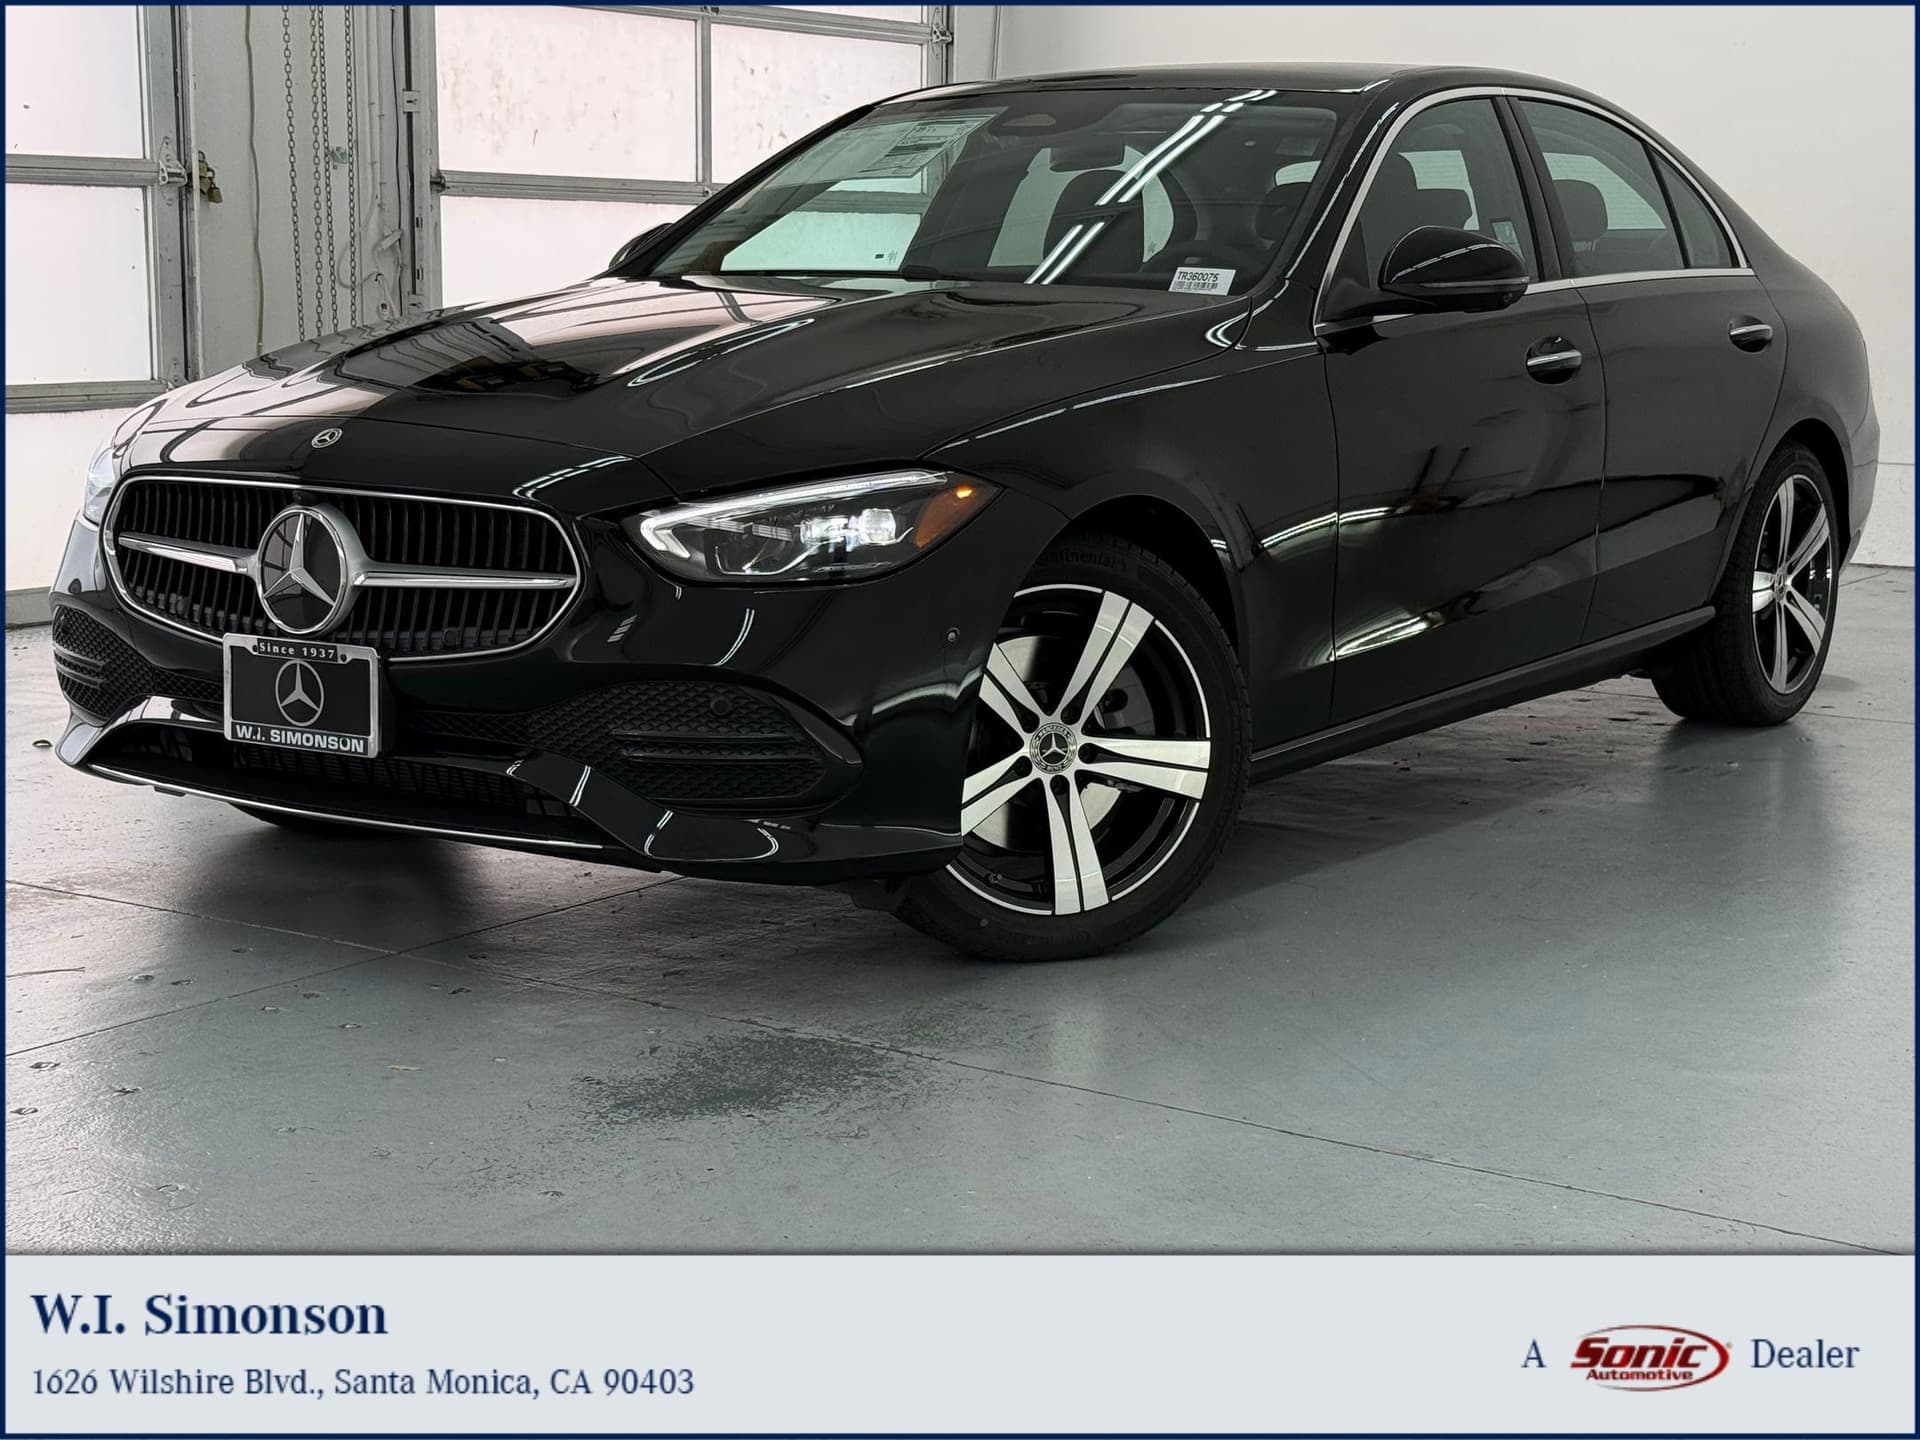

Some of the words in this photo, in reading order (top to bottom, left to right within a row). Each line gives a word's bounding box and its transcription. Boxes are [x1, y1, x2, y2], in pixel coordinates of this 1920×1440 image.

[1177, 271, 1219, 282] TR360075
[259, 642, 296, 655] Since
[302, 647, 336, 660] 1937
[236, 724, 266, 741] W.I.
[270, 729, 364, 753] SIMONSON
